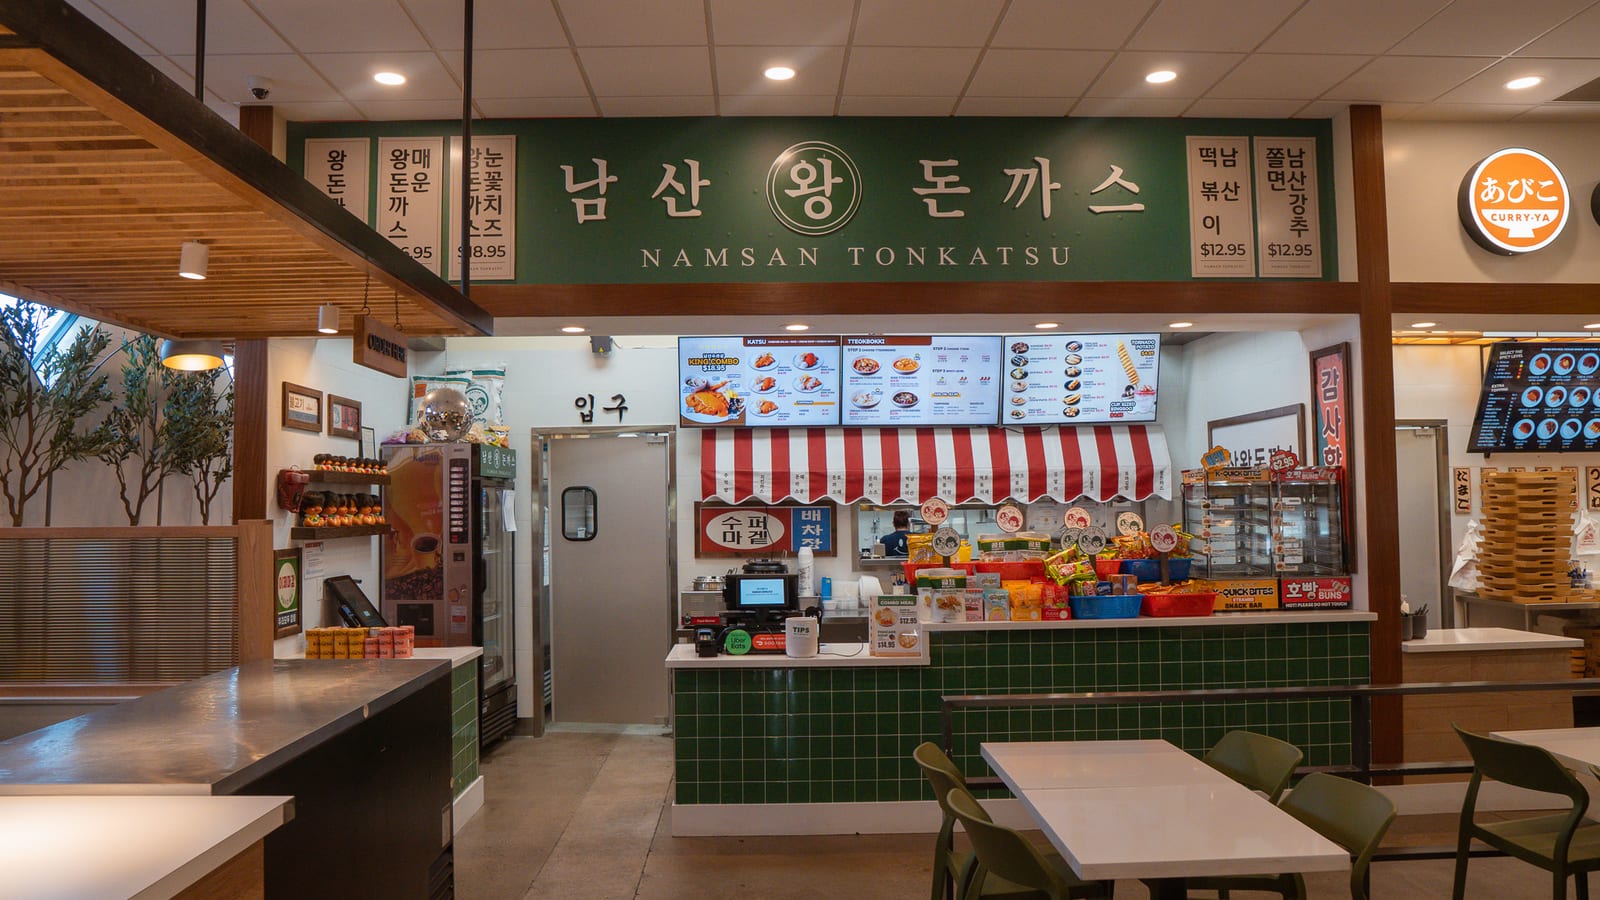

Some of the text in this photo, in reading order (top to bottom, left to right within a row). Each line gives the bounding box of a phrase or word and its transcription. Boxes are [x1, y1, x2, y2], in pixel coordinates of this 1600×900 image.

[388, 148, 431, 238] 매운 왕돈까스
[483, 147, 504, 237] 눈꽃치즈
[560, 157, 711, 225] 남산
[912, 156, 1145, 220] 돈까스
[1199, 148, 1240, 235] 남산 떡볶이
[1266, 148, 1309, 238] 남산강추 쫄면
[1480, 177, 1558, 204] あびこ
[1491, 213, 1550, 221] CURRY-YA
[640, 246, 1070, 268] NAMSAN TONKATSU
[1200, 242, 1246, 257] $12.95
[1268, 242, 1312, 257] $12.95
[575, 394, 628, 423] 입구
[1205, 451, 1225, 466] NEW
[1273, 455, 1295, 471] $2.95
[722, 515, 767, 530] 수퍼
[1249, 587, 1273, 595] BITES
[1286, 581, 1318, 600] 호빵
[1319, 591, 1342, 599] BUNS
